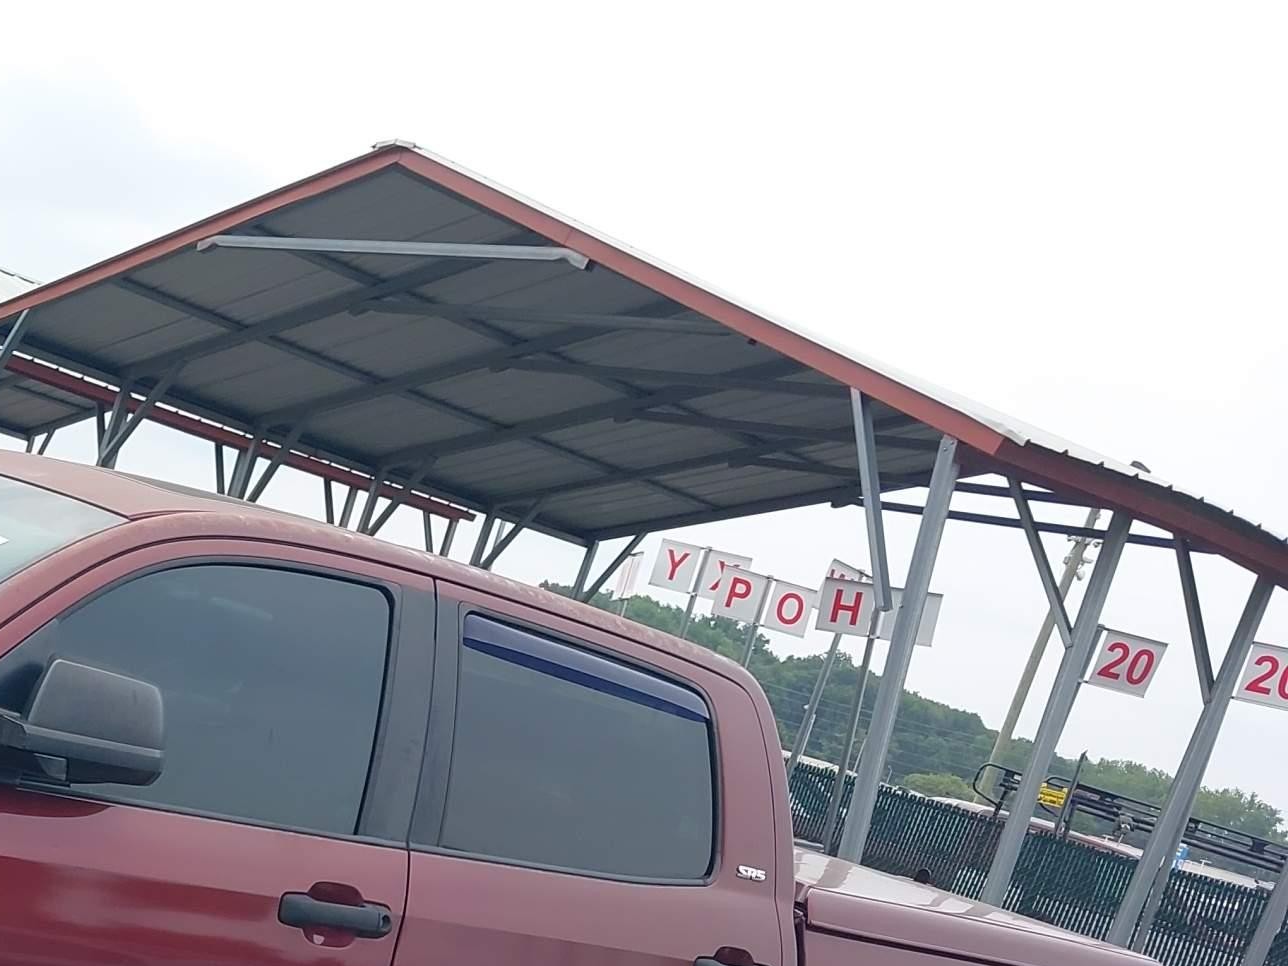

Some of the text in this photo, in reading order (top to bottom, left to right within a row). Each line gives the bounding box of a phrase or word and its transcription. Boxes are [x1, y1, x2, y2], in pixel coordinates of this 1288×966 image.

[667, 549, 691, 581] Y
[724, 576, 752, 608] P
[829, 588, 864, 626] H
[1096, 641, 1155, 686] 20
